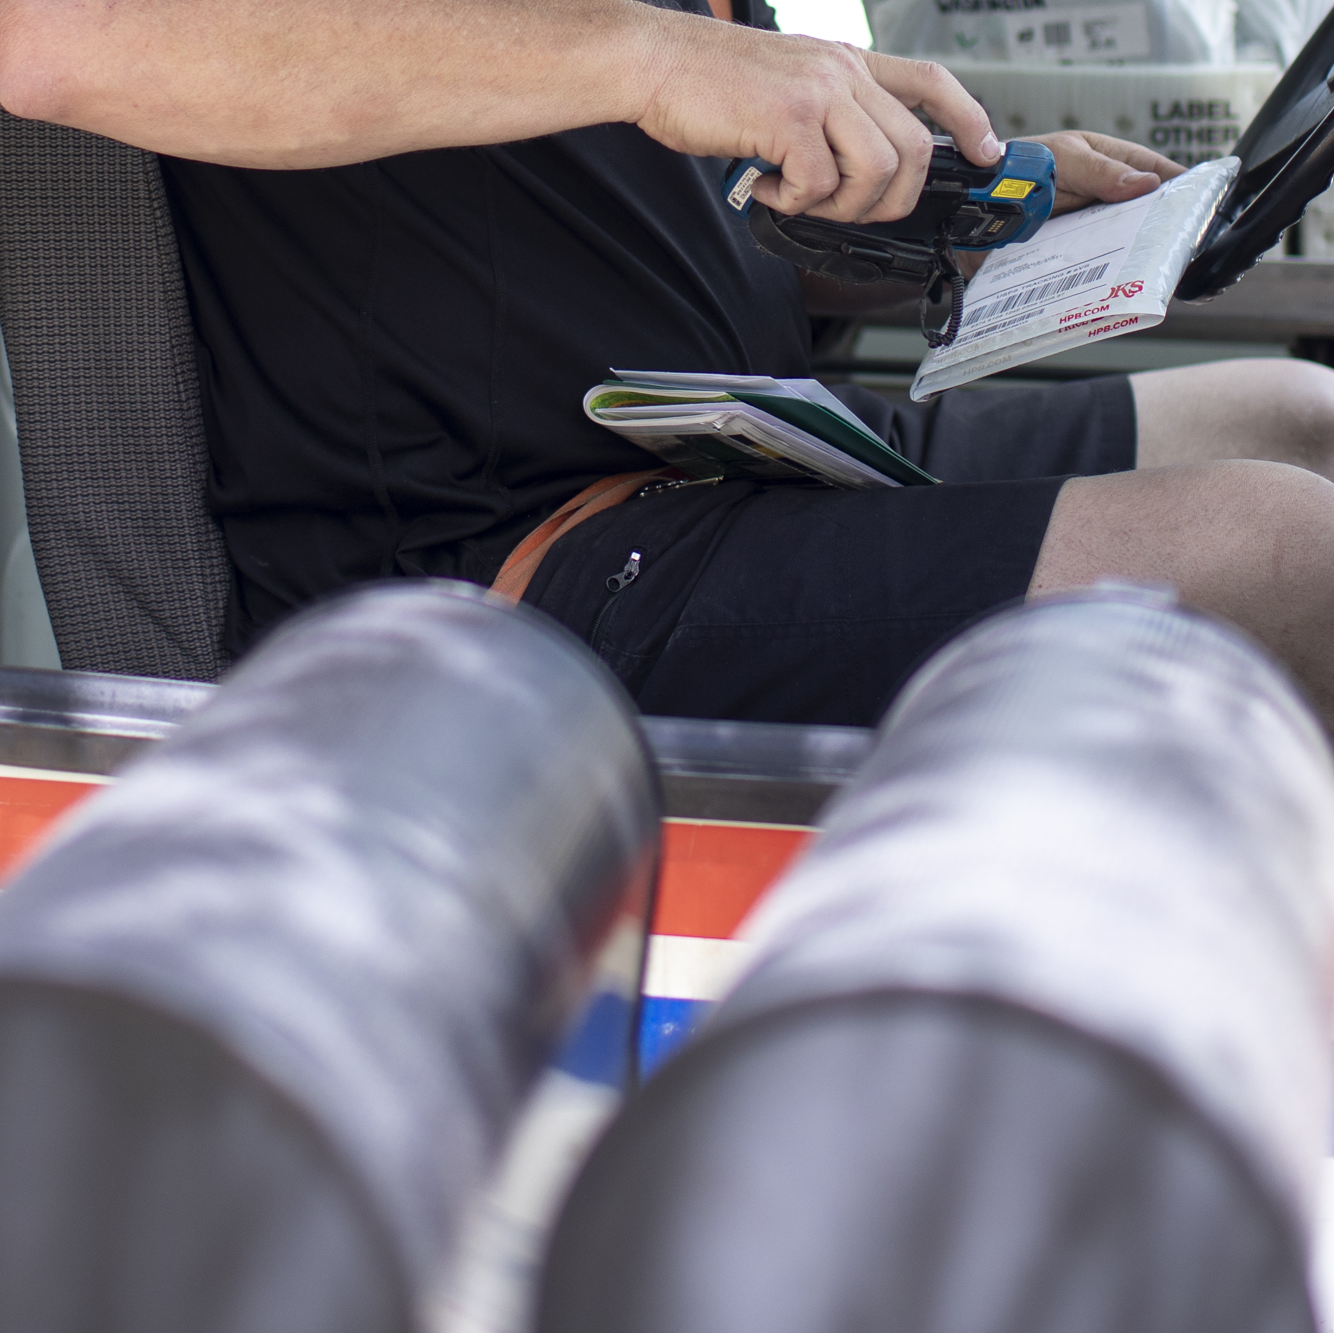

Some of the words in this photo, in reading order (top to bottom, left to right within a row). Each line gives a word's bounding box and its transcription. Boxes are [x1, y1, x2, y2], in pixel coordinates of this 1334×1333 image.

[1152, 100, 1238, 121] LABEL
[1150, 126, 1240, 147] OTHER
[1022, 271, 1064, 289] TRACKING
[1059, 304, 1110, 324] HPB.COM
[1088, 316, 1139, 337] HPB.COM
